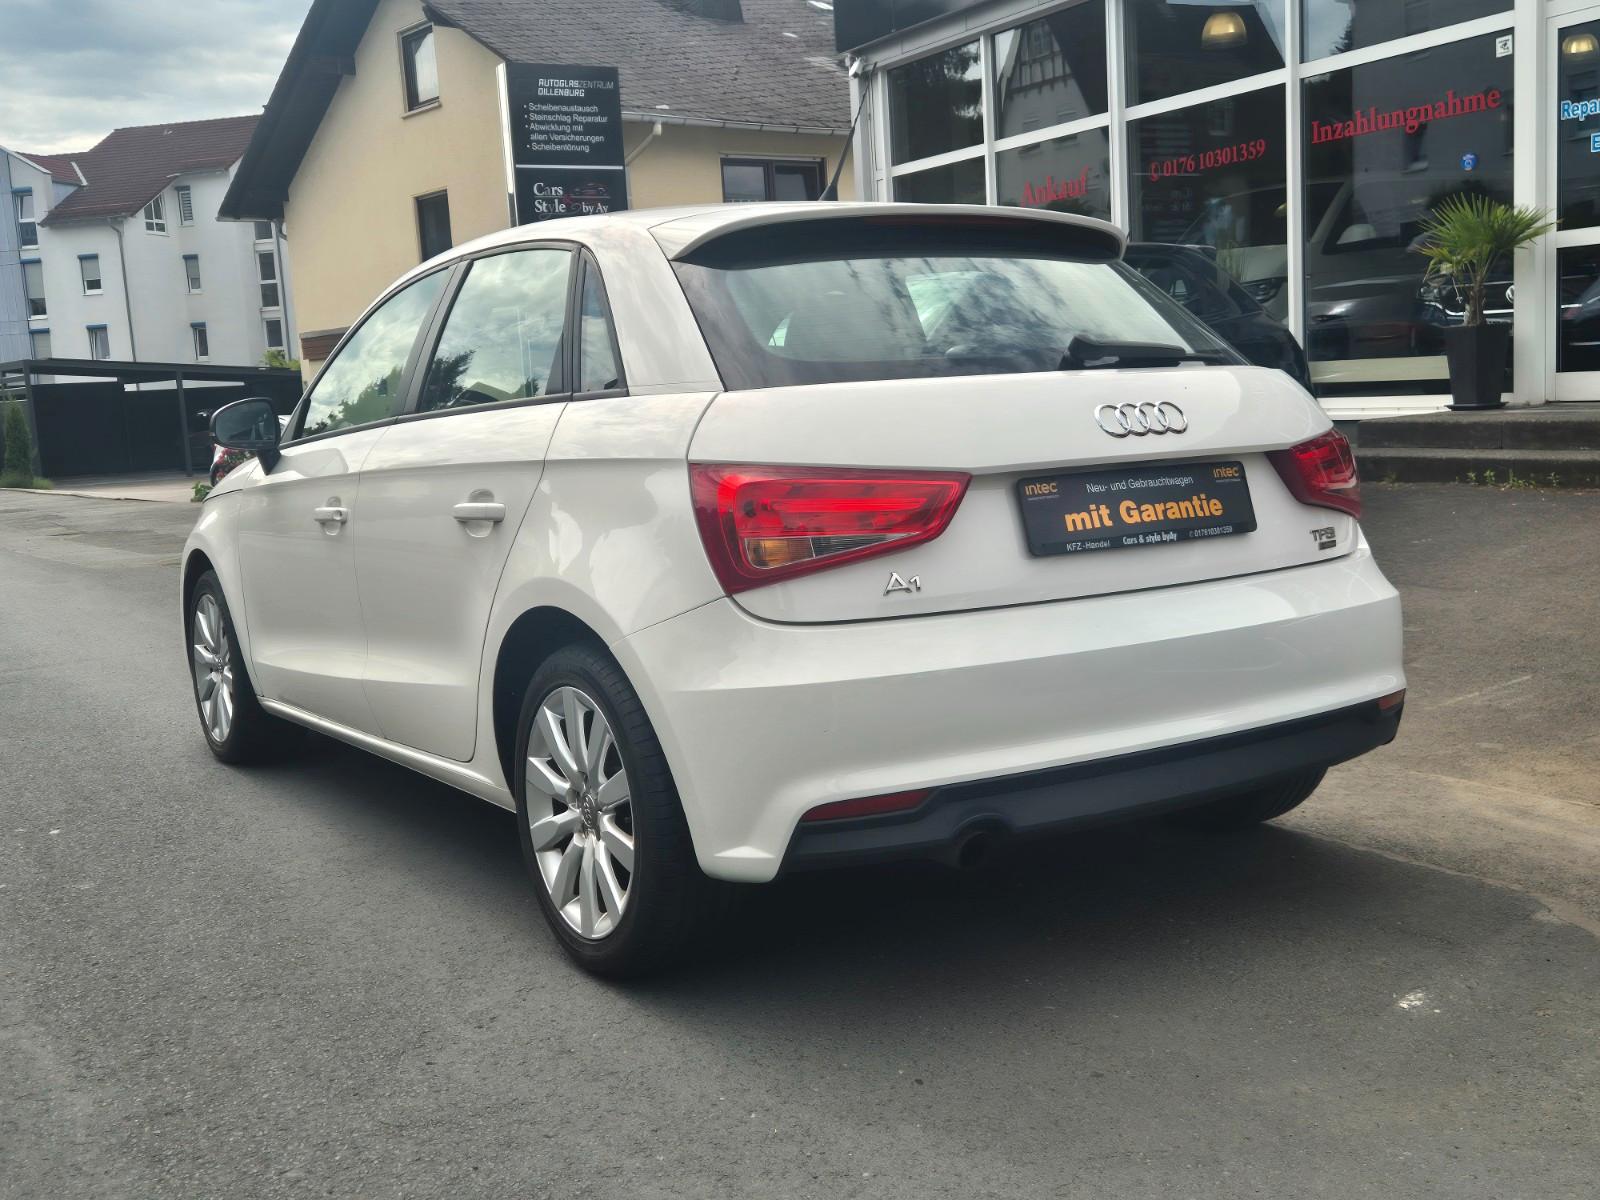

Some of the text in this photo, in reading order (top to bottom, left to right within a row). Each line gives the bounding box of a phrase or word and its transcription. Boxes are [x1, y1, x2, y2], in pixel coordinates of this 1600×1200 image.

[537, 87, 585, 97] DILLENBURG
[528, 102, 599, 113] Scheibenaustausch
[529, 113, 608, 123] Steinschlag Reparatur
[1311, 87, 1502, 144] Inzahlungnahme
[529, 123, 583, 133] Abwicklung mit
[530, 133, 605, 143] allen Versicherungen
[531, 143, 590, 153] Scheibentönung
[1163, 138, 1266, 177] 0176 10301359
[533, 182, 564, 197] Cars
[1020, 164, 1090, 208] Ankauf
[534, 199, 567, 214] Style
[582, 203, 594, 216] by
[1213, 466, 1240, 478] intec
[1025, 481, 1058, 496] intec
[1086, 475, 1194, 494] Neu- und Gebrauchtwagen
[1064, 493, 1224, 532] mit Garantie
[1122, 535, 1138, 545] Cars
[1145, 532, 1162, 544] style
[1066, 540, 1111, 552] KFZ-Handel
[882, 572, 921, 597] A1
